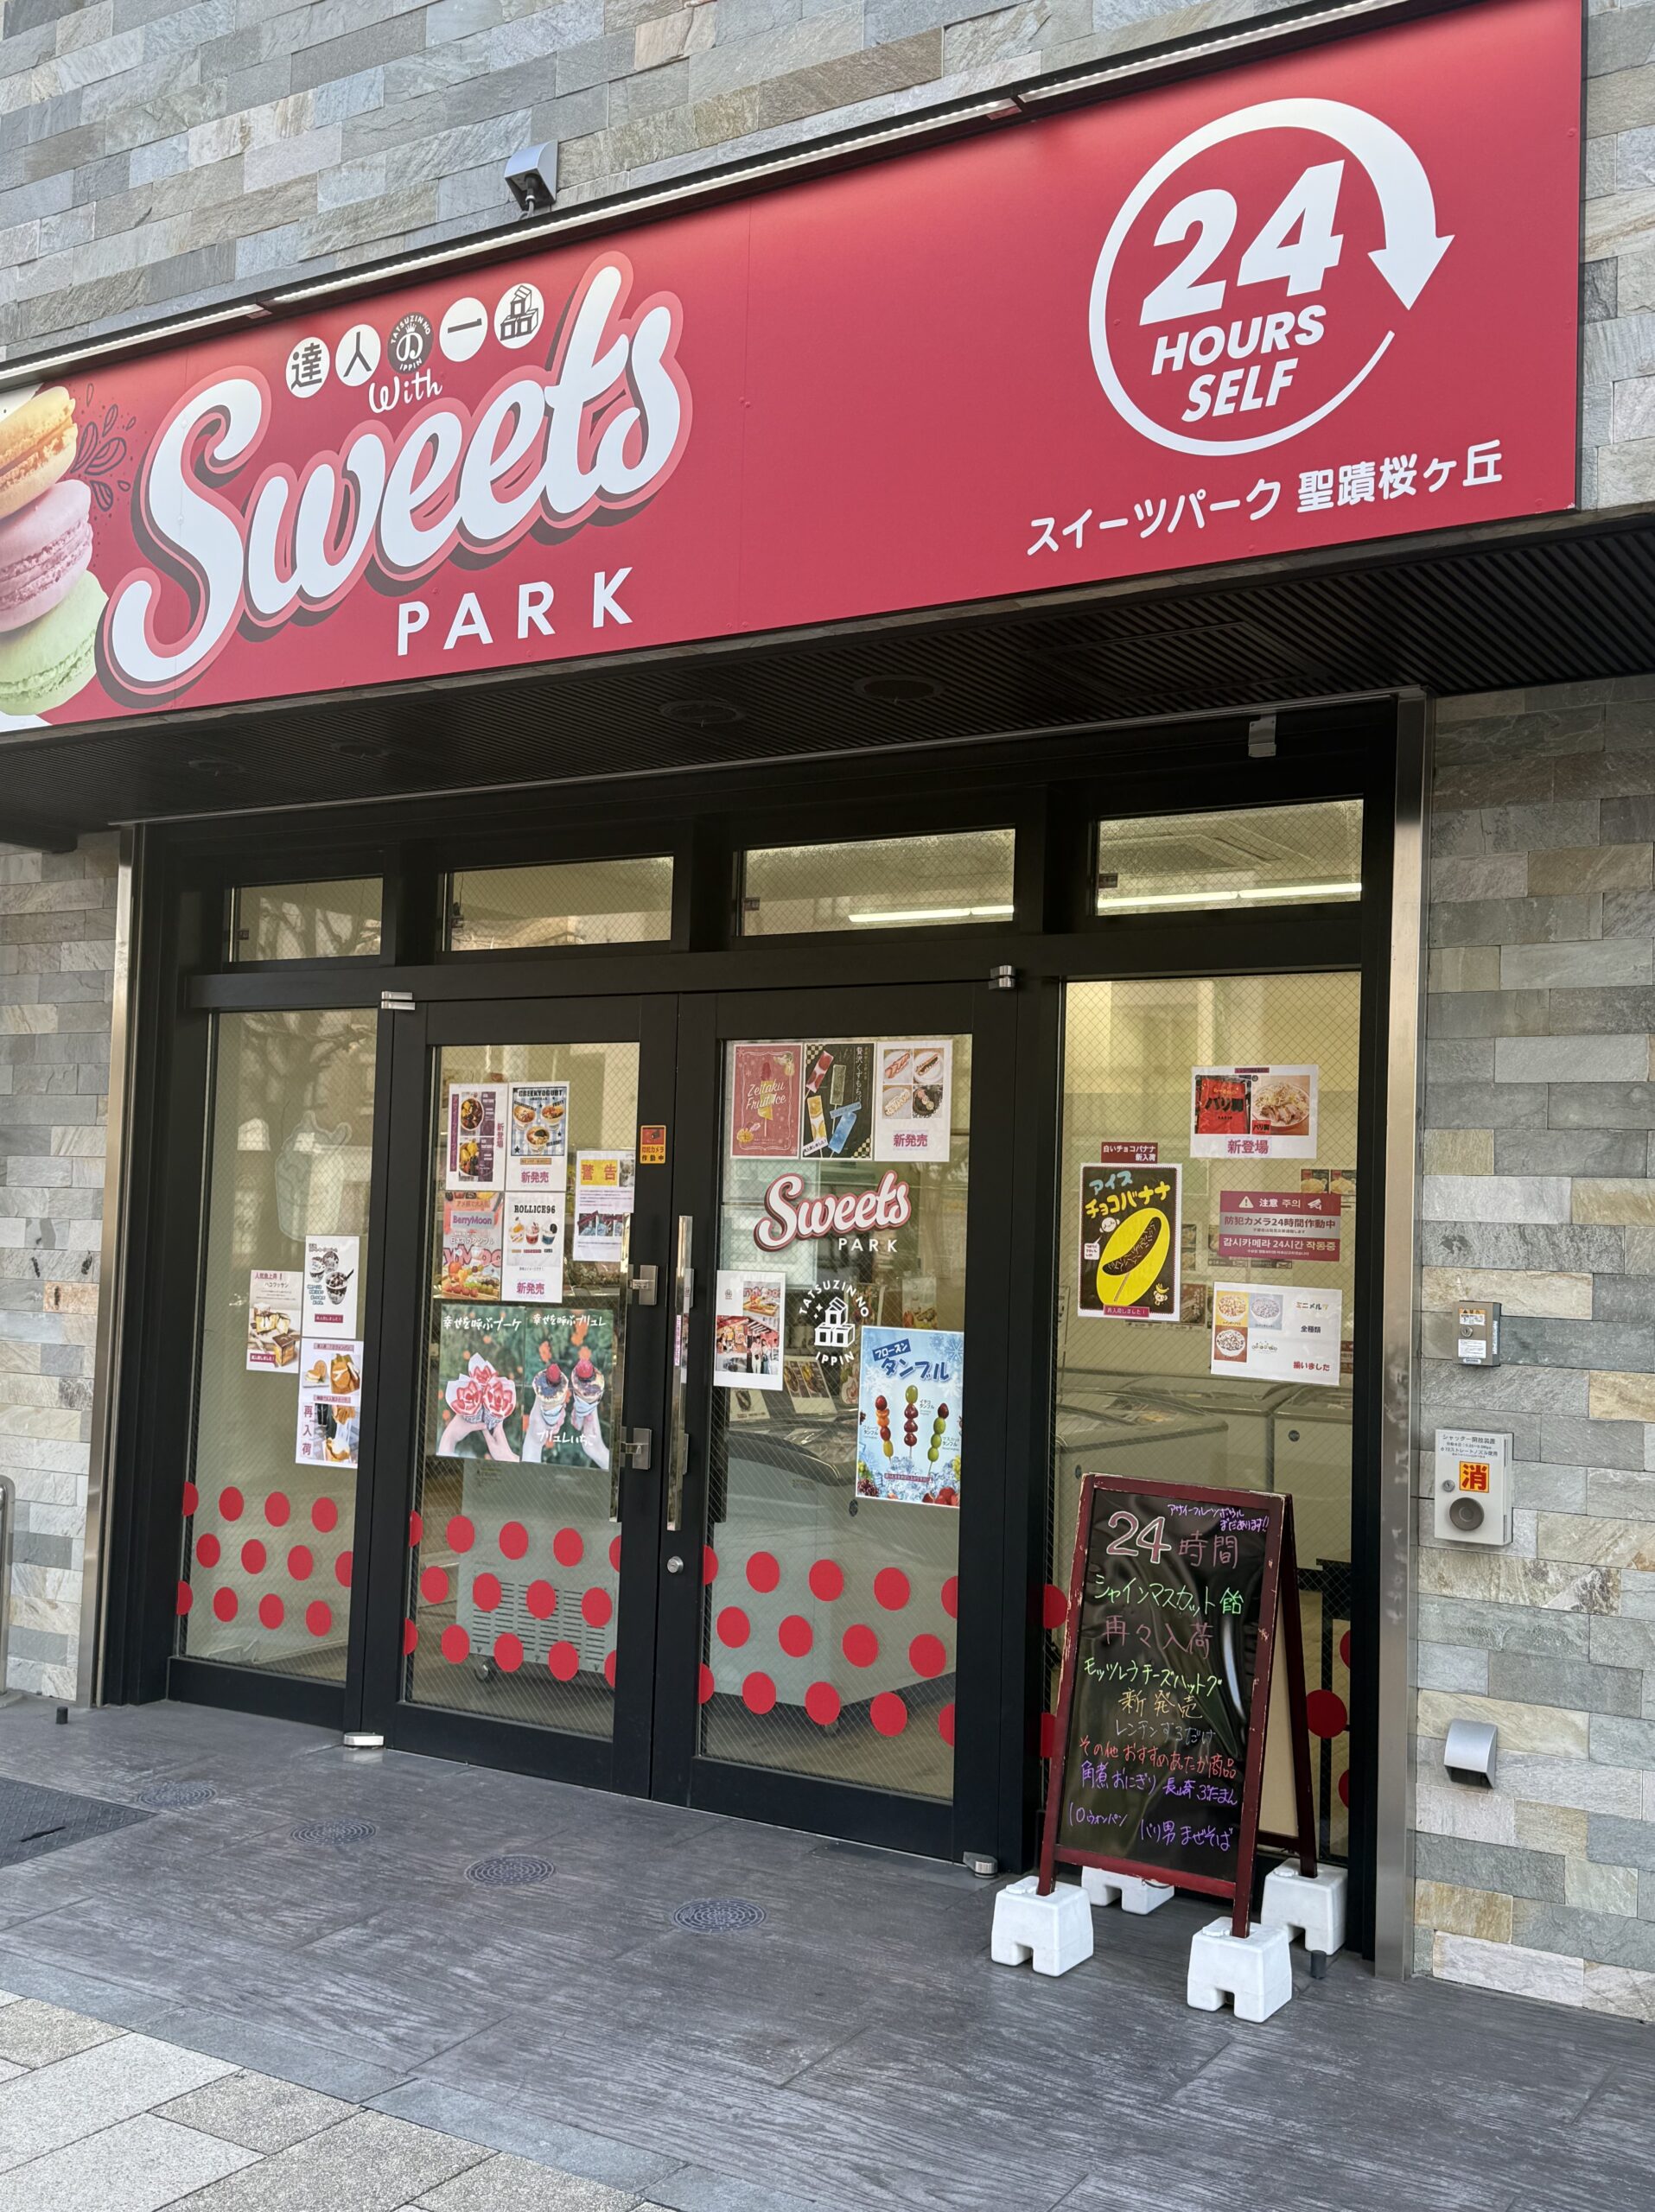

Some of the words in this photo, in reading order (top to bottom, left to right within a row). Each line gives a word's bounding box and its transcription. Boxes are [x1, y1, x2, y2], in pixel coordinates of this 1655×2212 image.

[1140, 159, 1345, 326] 24
[391, 315, 423, 344] TATSUZIN
[422, 321, 431, 335] NO
[1150, 304, 1327, 376] HOURS
[399, 358, 422, 372] IPPIN
[368, 368, 443, 414] With
[1181, 358, 1299, 423] SELF
[107, 257, 685, 689] Sweets
[1026, 478, 1282, 556] スイーツパーク
[1296, 440, 1503, 513] 聖蹟桜ヶ丘
[397, 567, 633, 658] PARK
[747, 1079, 785, 1097] Zeitaku
[746, 1094, 771, 1109] Fruit
[772, 1092, 786, 1105] Ice
[893, 1133, 928, 1147] 新発売
[1227, 1139, 1270, 1154] 新登場
[1103, 1145, 1156, 1154] 白いチョコバナナ
[520, 1171, 550, 1184] 新発売
[1089, 1170, 1133, 1196] アイス
[1085, 1181, 1171, 1219] チョコバナナ
[1258, 1198, 1278, 1208] 注意
[1282, 1198, 1301, 1209] 주의
[514, 1205, 556, 1214] ROLLICE96
[754, 1170, 912, 1252] Sweets
[453, 1215, 493, 1226] BerryMoon
[1224, 1216, 1336, 1229] 防犯カメラ24時間作動中
[838, 1237, 899, 1253] PARK
[1223, 1237, 1271, 1248] 감시카메라
[1272, 1239, 1303, 1249] 24시간
[1306, 1240, 1336, 1251] 작동중
[516, 1281, 545, 1295] 新発売
[799, 1279, 857, 1315] TATSUZIN
[855, 1297, 869, 1318] NO
[1301, 1325, 1321, 1333] 全種類
[815, 1351, 855, 1366] IPPIN
[1293, 1361, 1330, 1371] 揃いました
[302, 1405, 314, 1456] 再入荷
[1461, 1464, 1488, 1491] 消
[1104, 1614, 1213, 1660] 再々入荷
[1118, 1688, 1203, 1719] 新発売
